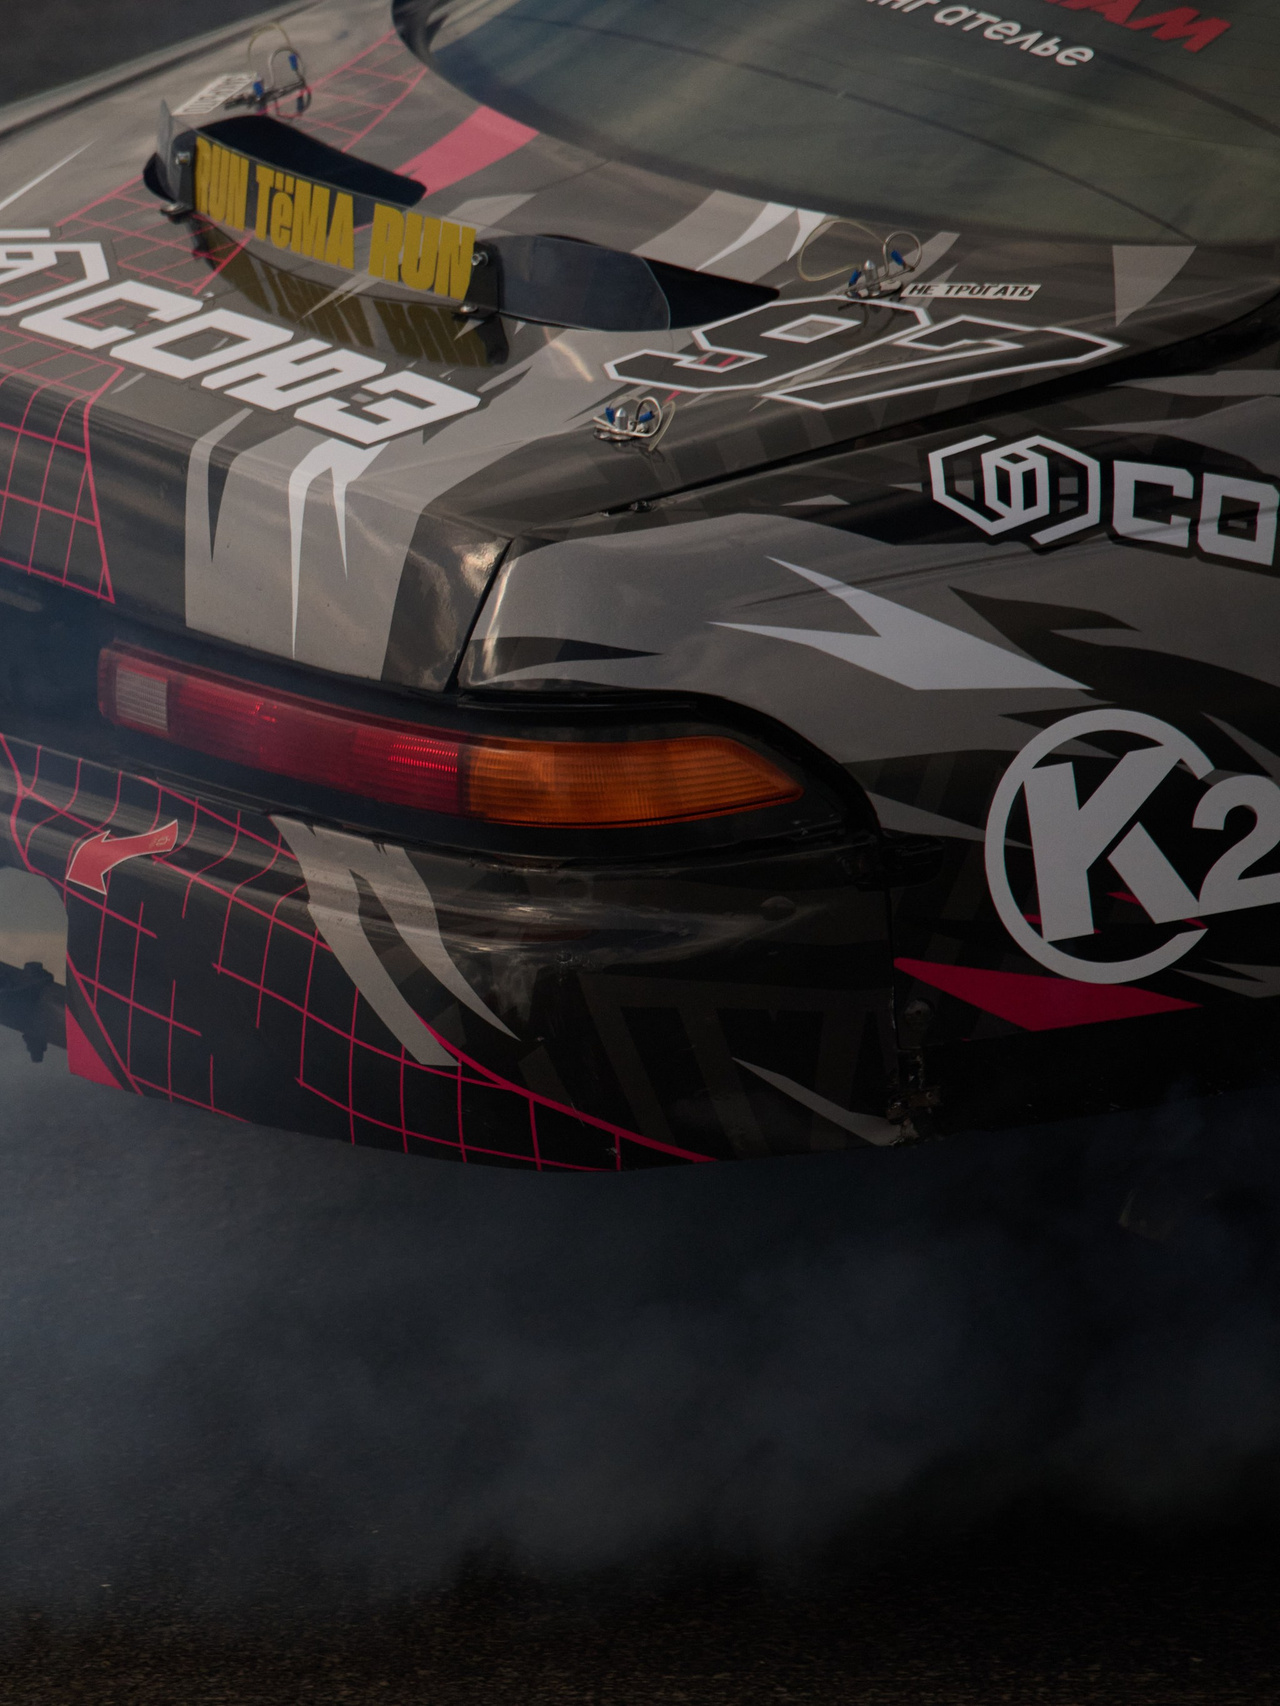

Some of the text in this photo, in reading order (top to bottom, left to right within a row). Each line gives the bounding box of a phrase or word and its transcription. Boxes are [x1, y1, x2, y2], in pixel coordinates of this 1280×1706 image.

[933, 4, 1095, 67] ателье
[196, 136, 250, 231] RUN
[369, 203, 477, 301] RUN
[909, 284, 1034, 297] НЕ ТРОГАТЬ
